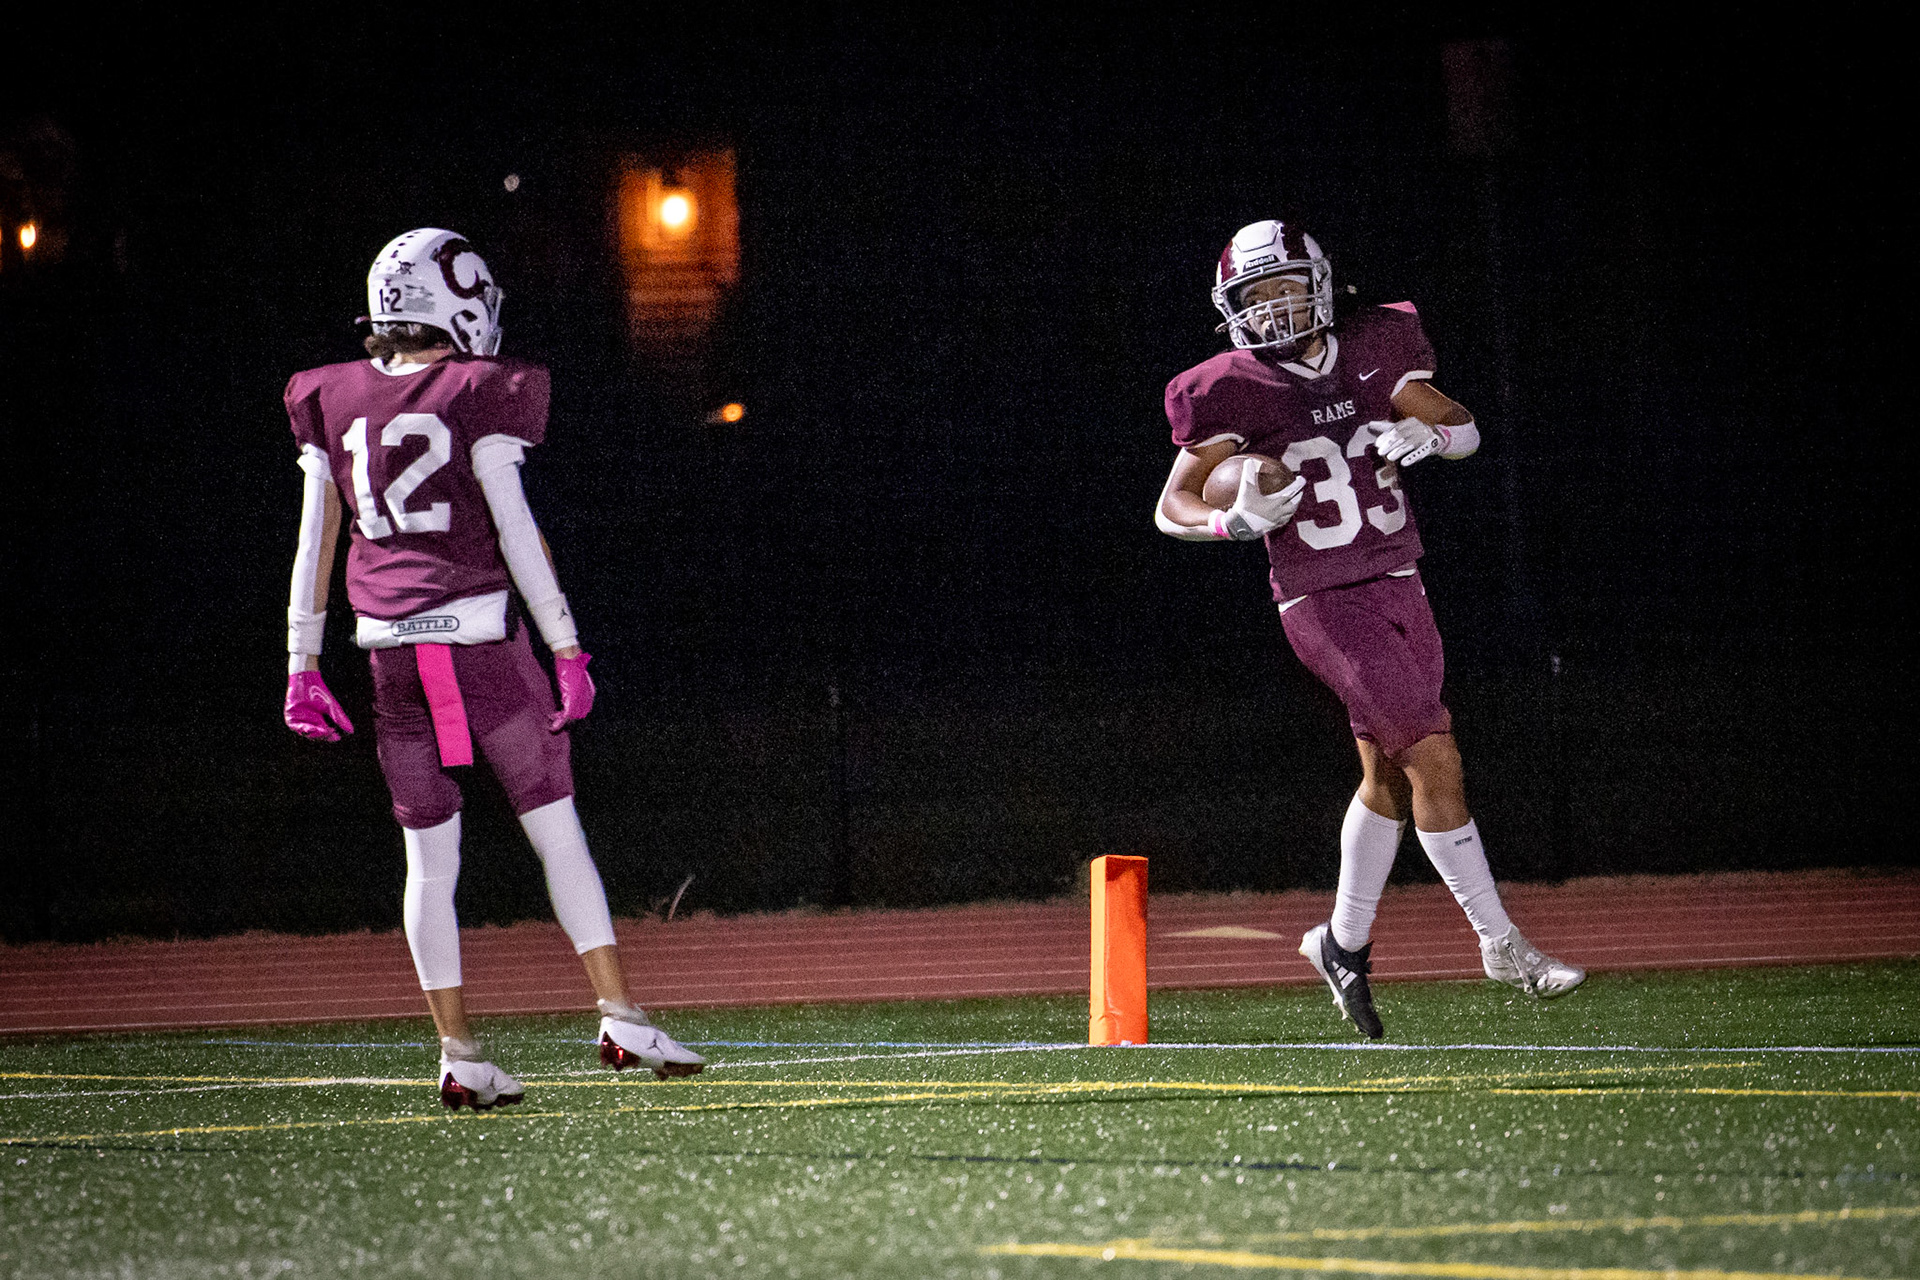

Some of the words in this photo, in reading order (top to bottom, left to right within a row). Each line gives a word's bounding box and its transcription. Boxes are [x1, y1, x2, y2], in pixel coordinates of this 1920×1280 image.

[1245, 255, 1275, 269] Riddell
[379, 288, 403, 313] 12
[1310, 400, 1356, 425] RAMS
[341, 413, 451, 540] 12
[1281, 422, 1407, 550] 33
[397, 619, 453, 633] BATTLE
